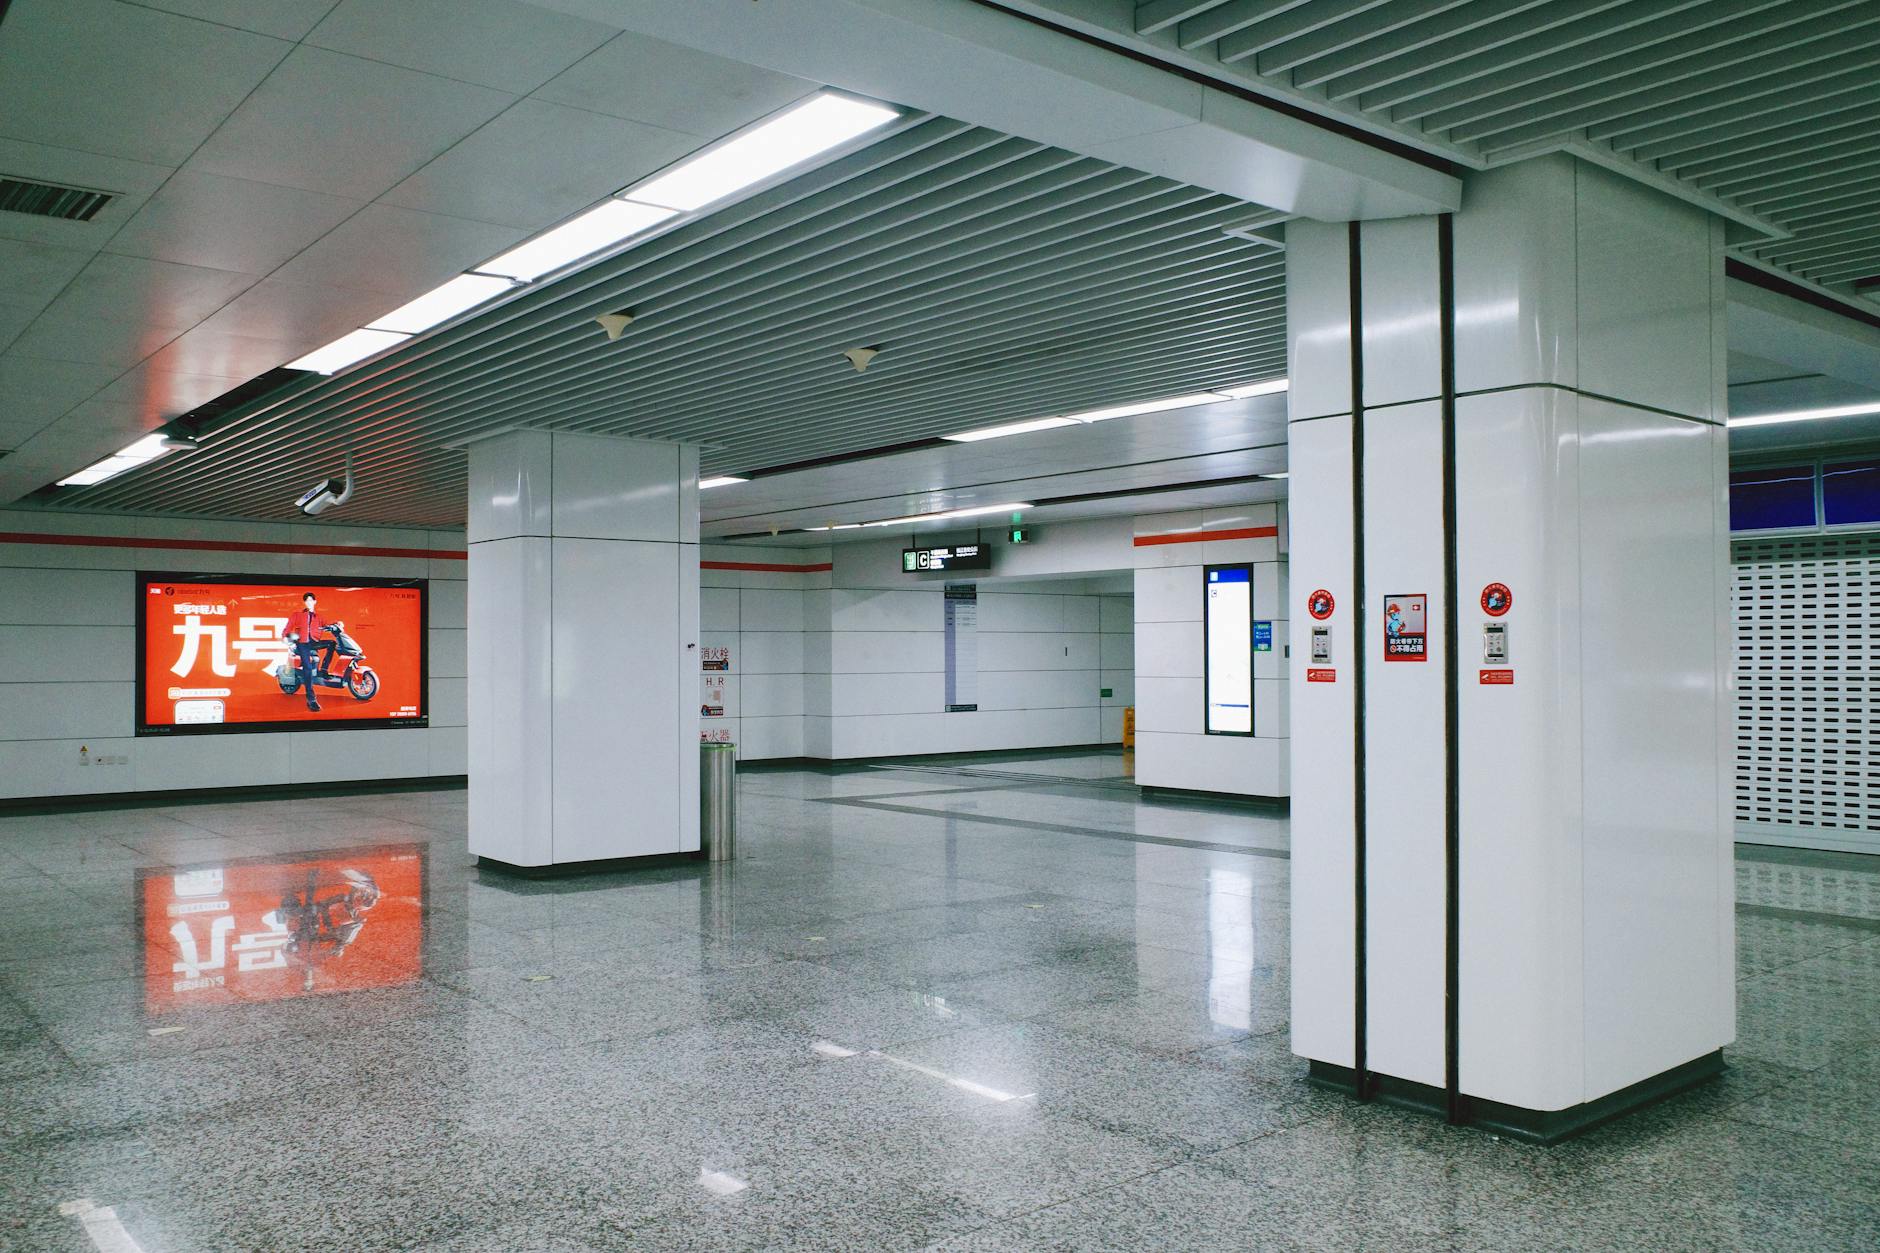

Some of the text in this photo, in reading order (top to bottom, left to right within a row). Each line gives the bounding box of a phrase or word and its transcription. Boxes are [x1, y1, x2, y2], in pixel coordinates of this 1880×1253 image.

[920, 554, 927, 566] C
[170, 615, 290, 678] 九号
[701, 648, 728, 660] 消火栓
